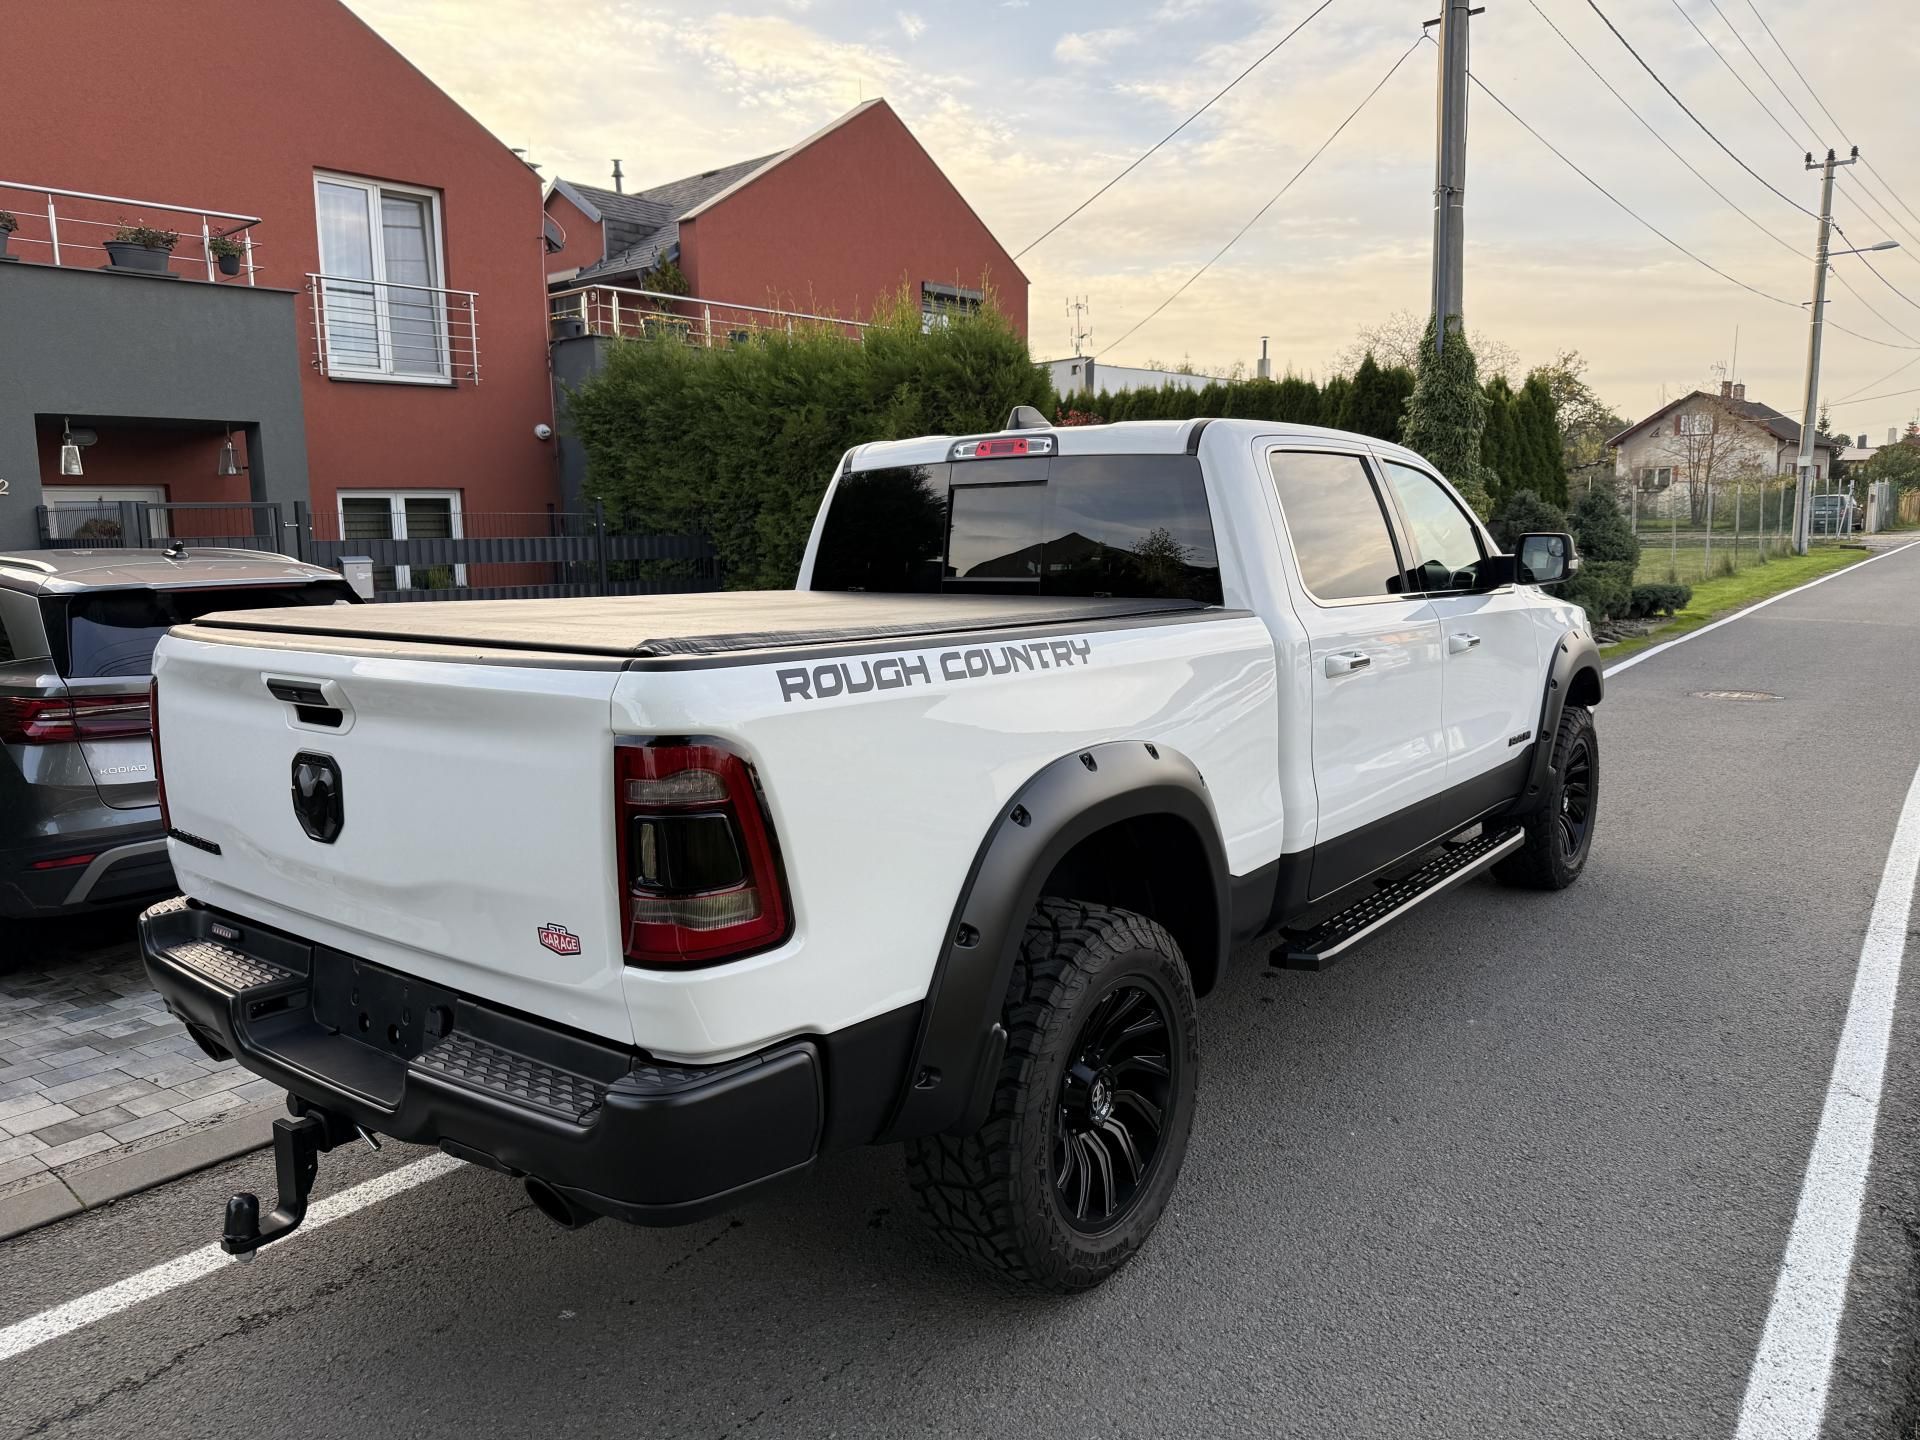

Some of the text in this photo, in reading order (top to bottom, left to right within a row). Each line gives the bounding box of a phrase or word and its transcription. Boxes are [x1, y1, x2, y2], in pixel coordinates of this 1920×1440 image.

[776, 639, 1091, 702] ROUGH COUNTRY
[100, 764, 148, 776] KODIAQ
[542, 931, 578, 950] GARAGE
